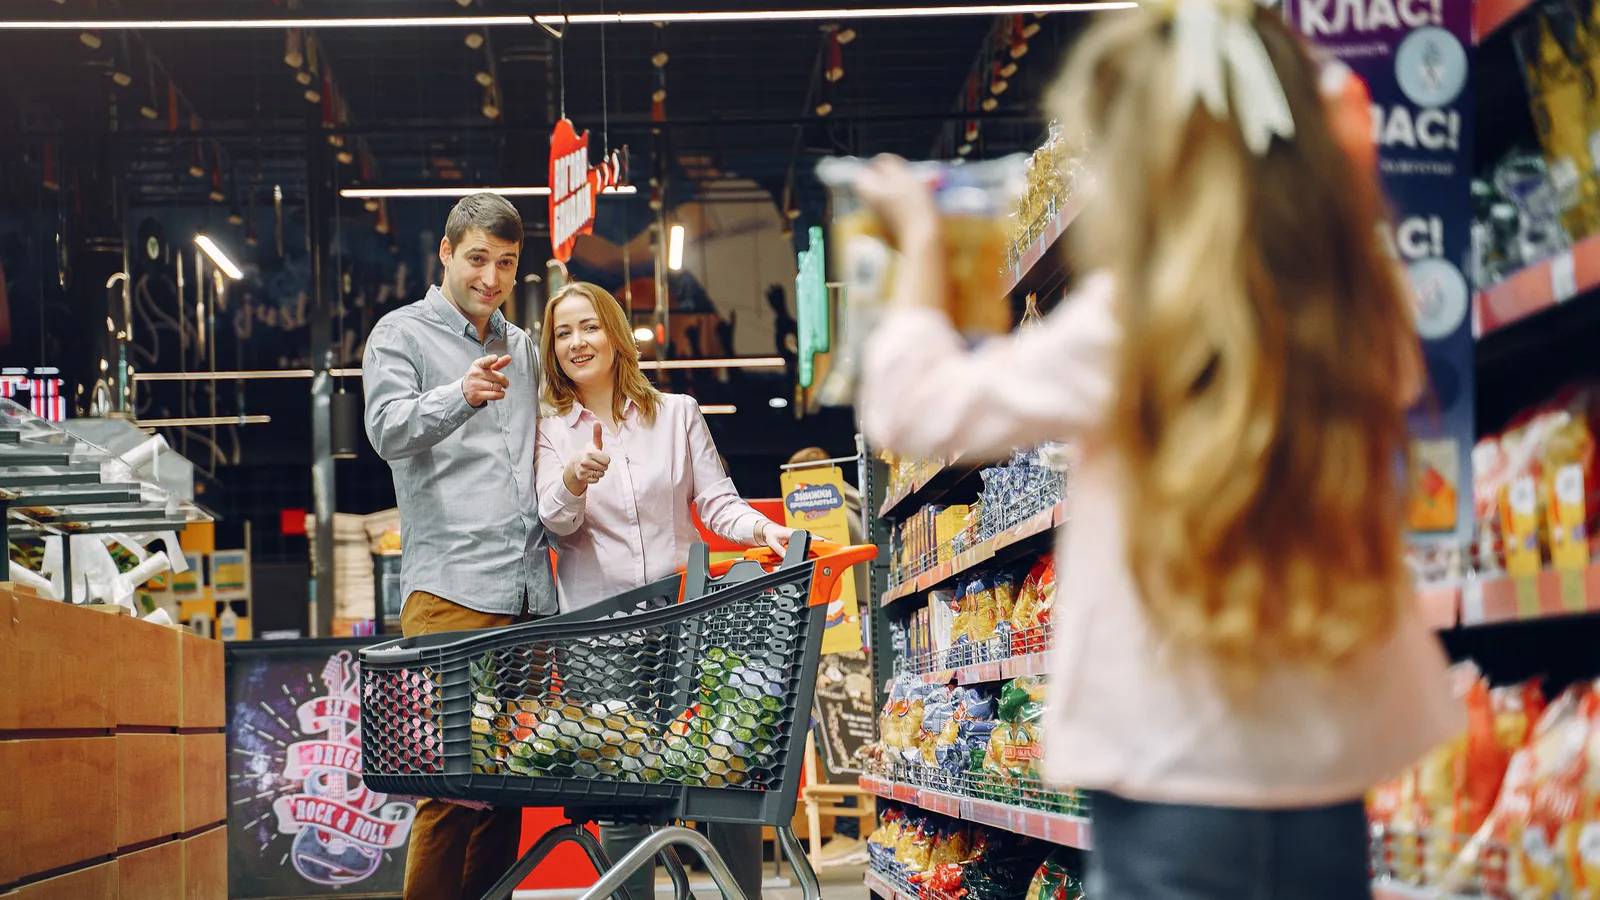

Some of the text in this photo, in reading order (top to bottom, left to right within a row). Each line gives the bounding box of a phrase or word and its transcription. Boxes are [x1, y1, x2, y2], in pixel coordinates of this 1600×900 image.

[1299, 0, 1444, 36] КЛАС!
[313, 744, 362, 772] DRUGS
[295, 800, 387, 846] ROCK & ROLL
